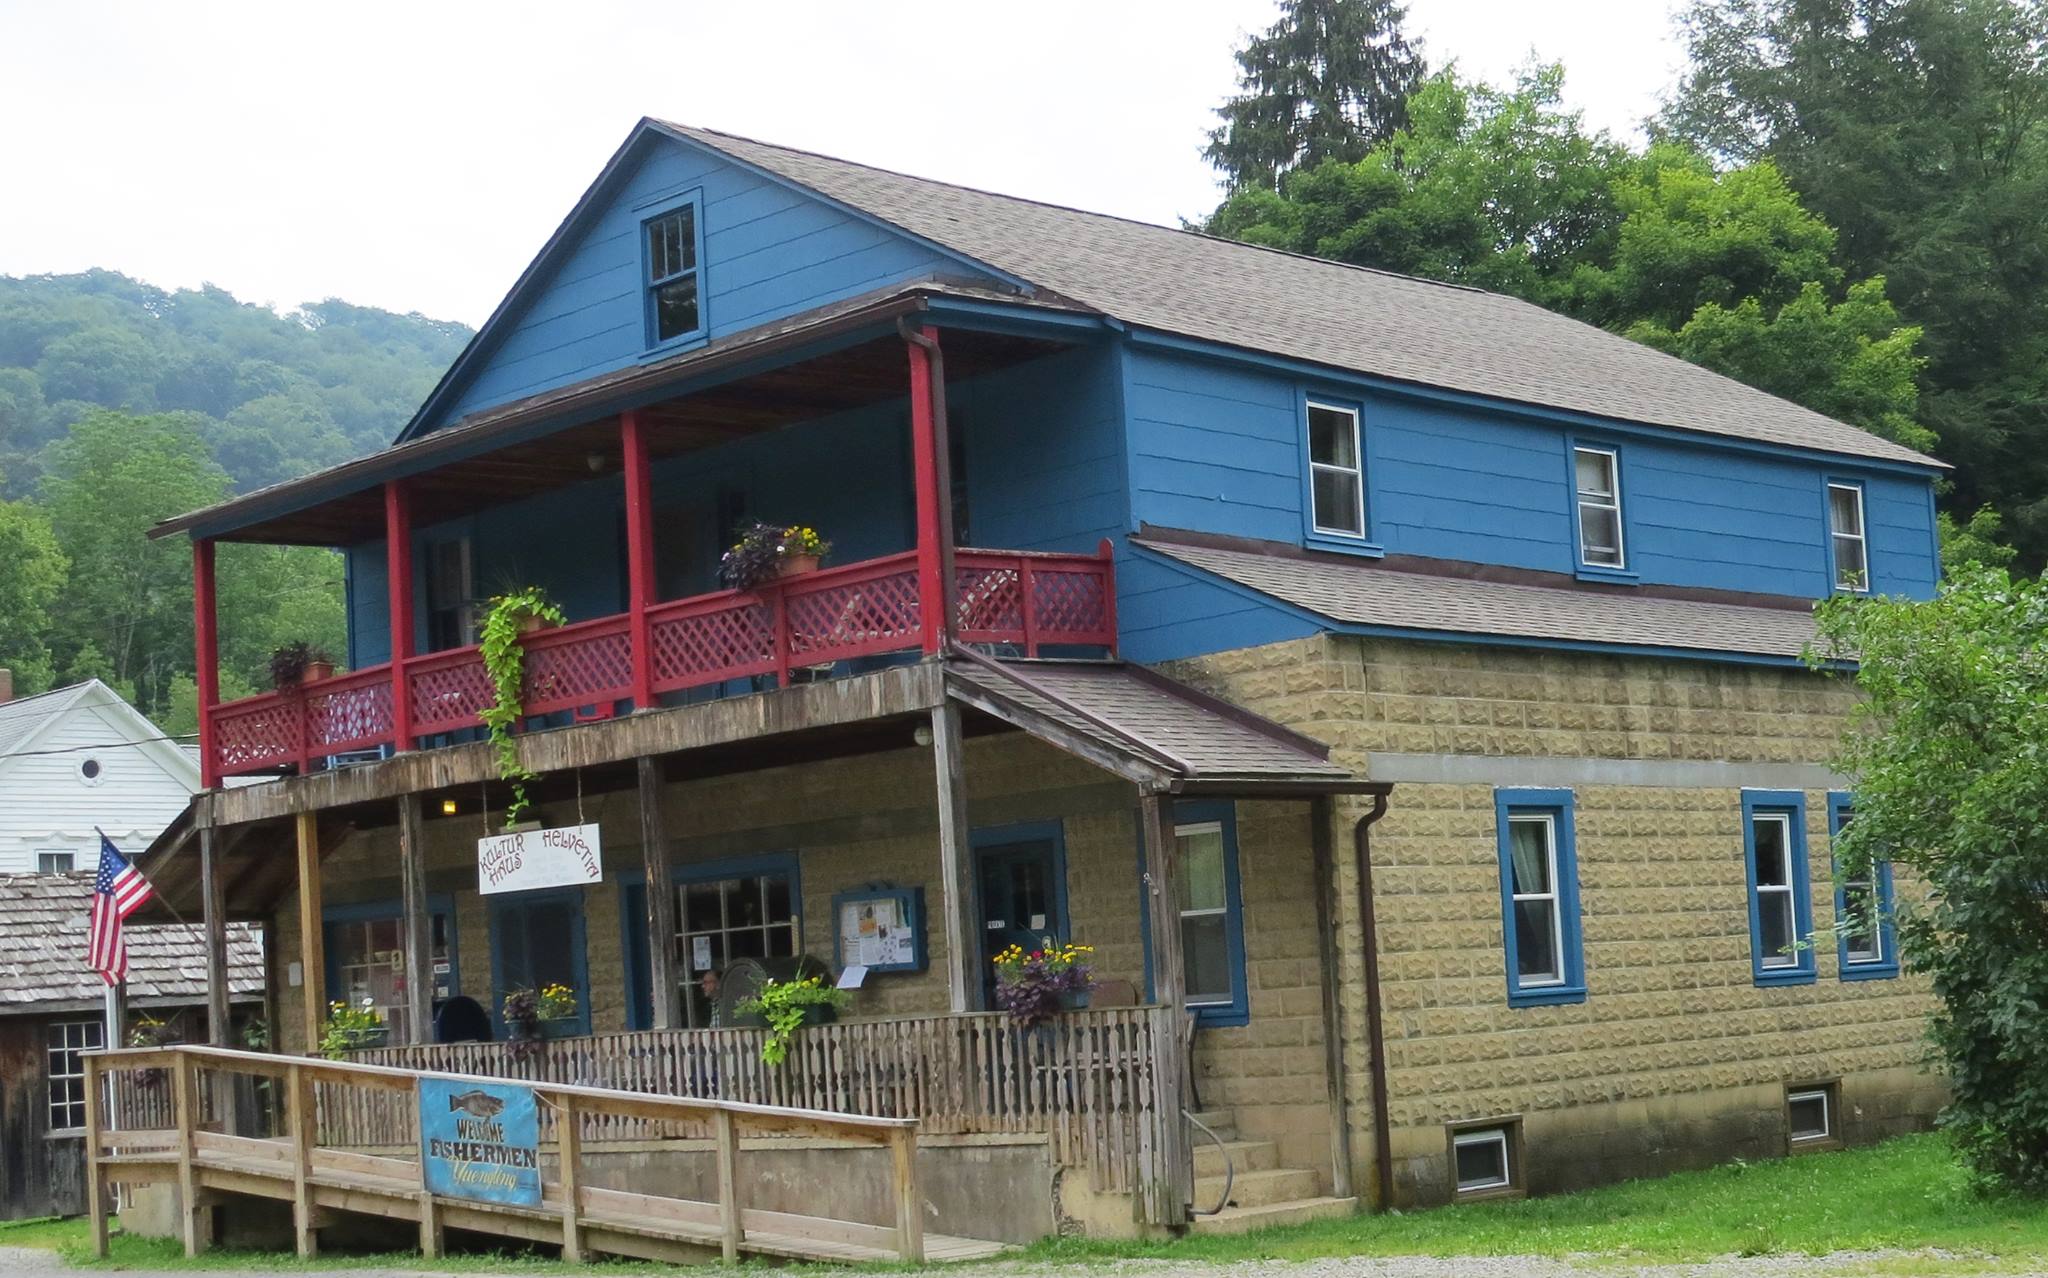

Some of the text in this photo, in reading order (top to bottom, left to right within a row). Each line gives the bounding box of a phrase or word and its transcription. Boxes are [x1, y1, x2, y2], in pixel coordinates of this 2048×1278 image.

[480, 834, 525, 874] KULTUR
[489, 853, 522, 886] HAUS
[430, 1138, 537, 1168] FISHERMEN
